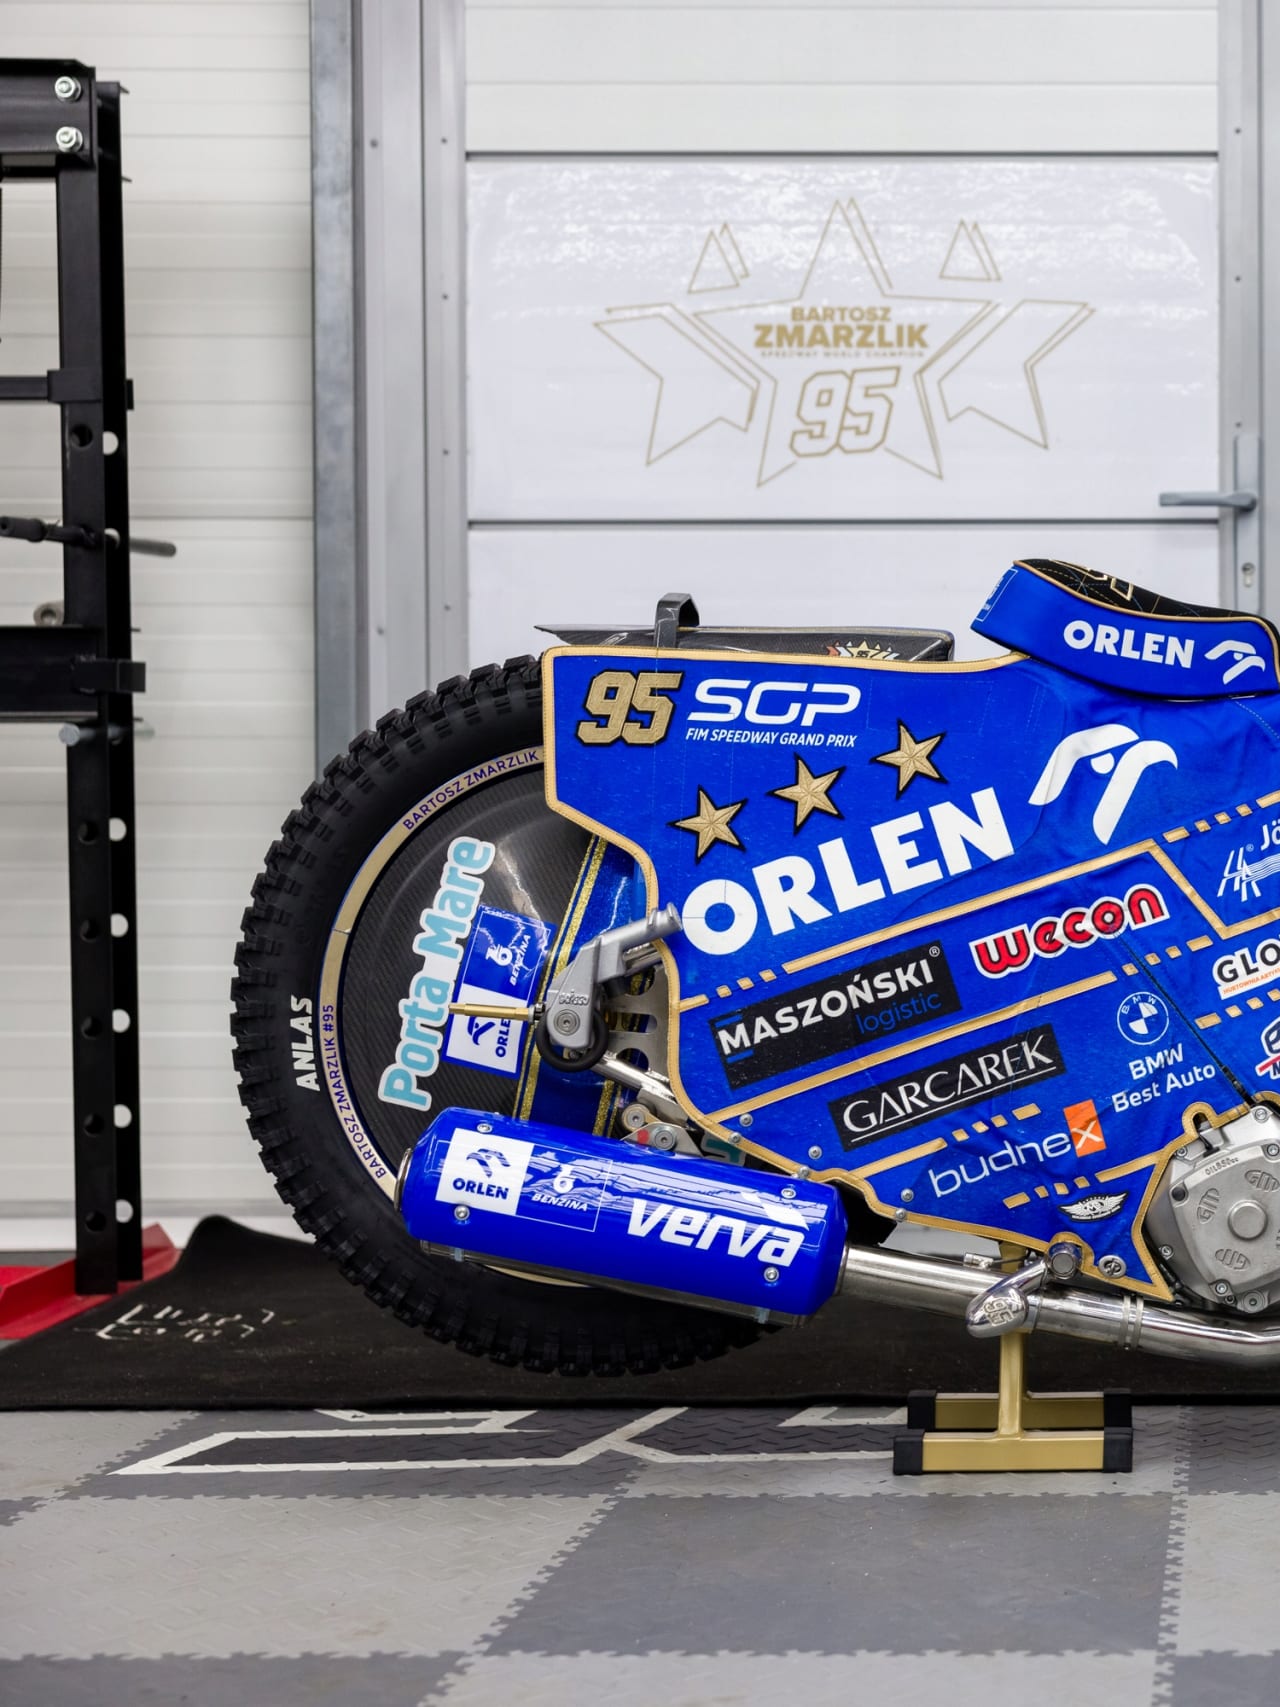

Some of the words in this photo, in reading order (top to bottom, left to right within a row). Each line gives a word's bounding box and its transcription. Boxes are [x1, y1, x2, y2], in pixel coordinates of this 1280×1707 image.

[754, 324, 929, 348] ZMARZLIK
[791, 306, 892, 322] BARTOSZ
[790, 365, 901, 458] 95
[1063, 620, 1195, 669] ORLEN
[577, 670, 683, 746] 95
[687, 678, 861, 727] SGP
[685, 728, 709, 741] FIM
[710, 729, 779, 745] SPEEDWAY
[779, 732, 824, 747] GRAND
[826, 734, 857, 748] PRIX
[403, 781, 464, 830] BARTOSZ
[464, 750, 540, 786] ZMARZLIK
[418, 838, 492, 959] Mare
[682, 787, 1015, 956] ORLEN
[509, 935, 531, 986] BENZINA
[972, 886, 1168, 976] wecon
[322, 1004, 335, 1032] #95
[495, 1018, 511, 1058] ORLE
[717, 959, 934, 1054] MASZOŃSKI
[855, 991, 942, 1034] logistic
[290, 993, 320, 1091] ANLAS
[383, 975, 450, 1107] Porta
[1129, 1043, 1184, 1080] BMW
[324, 1037, 351, 1113] ZMARZLIK
[843, 1034, 1053, 1132] GARCAREK
[1112, 1084, 1160, 1113] Best
[1166, 1064, 1216, 1094] Auto
[344, 1112, 387, 1179] BARTOSZ
[928, 1119, 1103, 1198] budnex
[453, 1176, 509, 1201] ORLEN
[531, 1191, 588, 1213] BENZINA
[627, 1199, 805, 1267] verva
